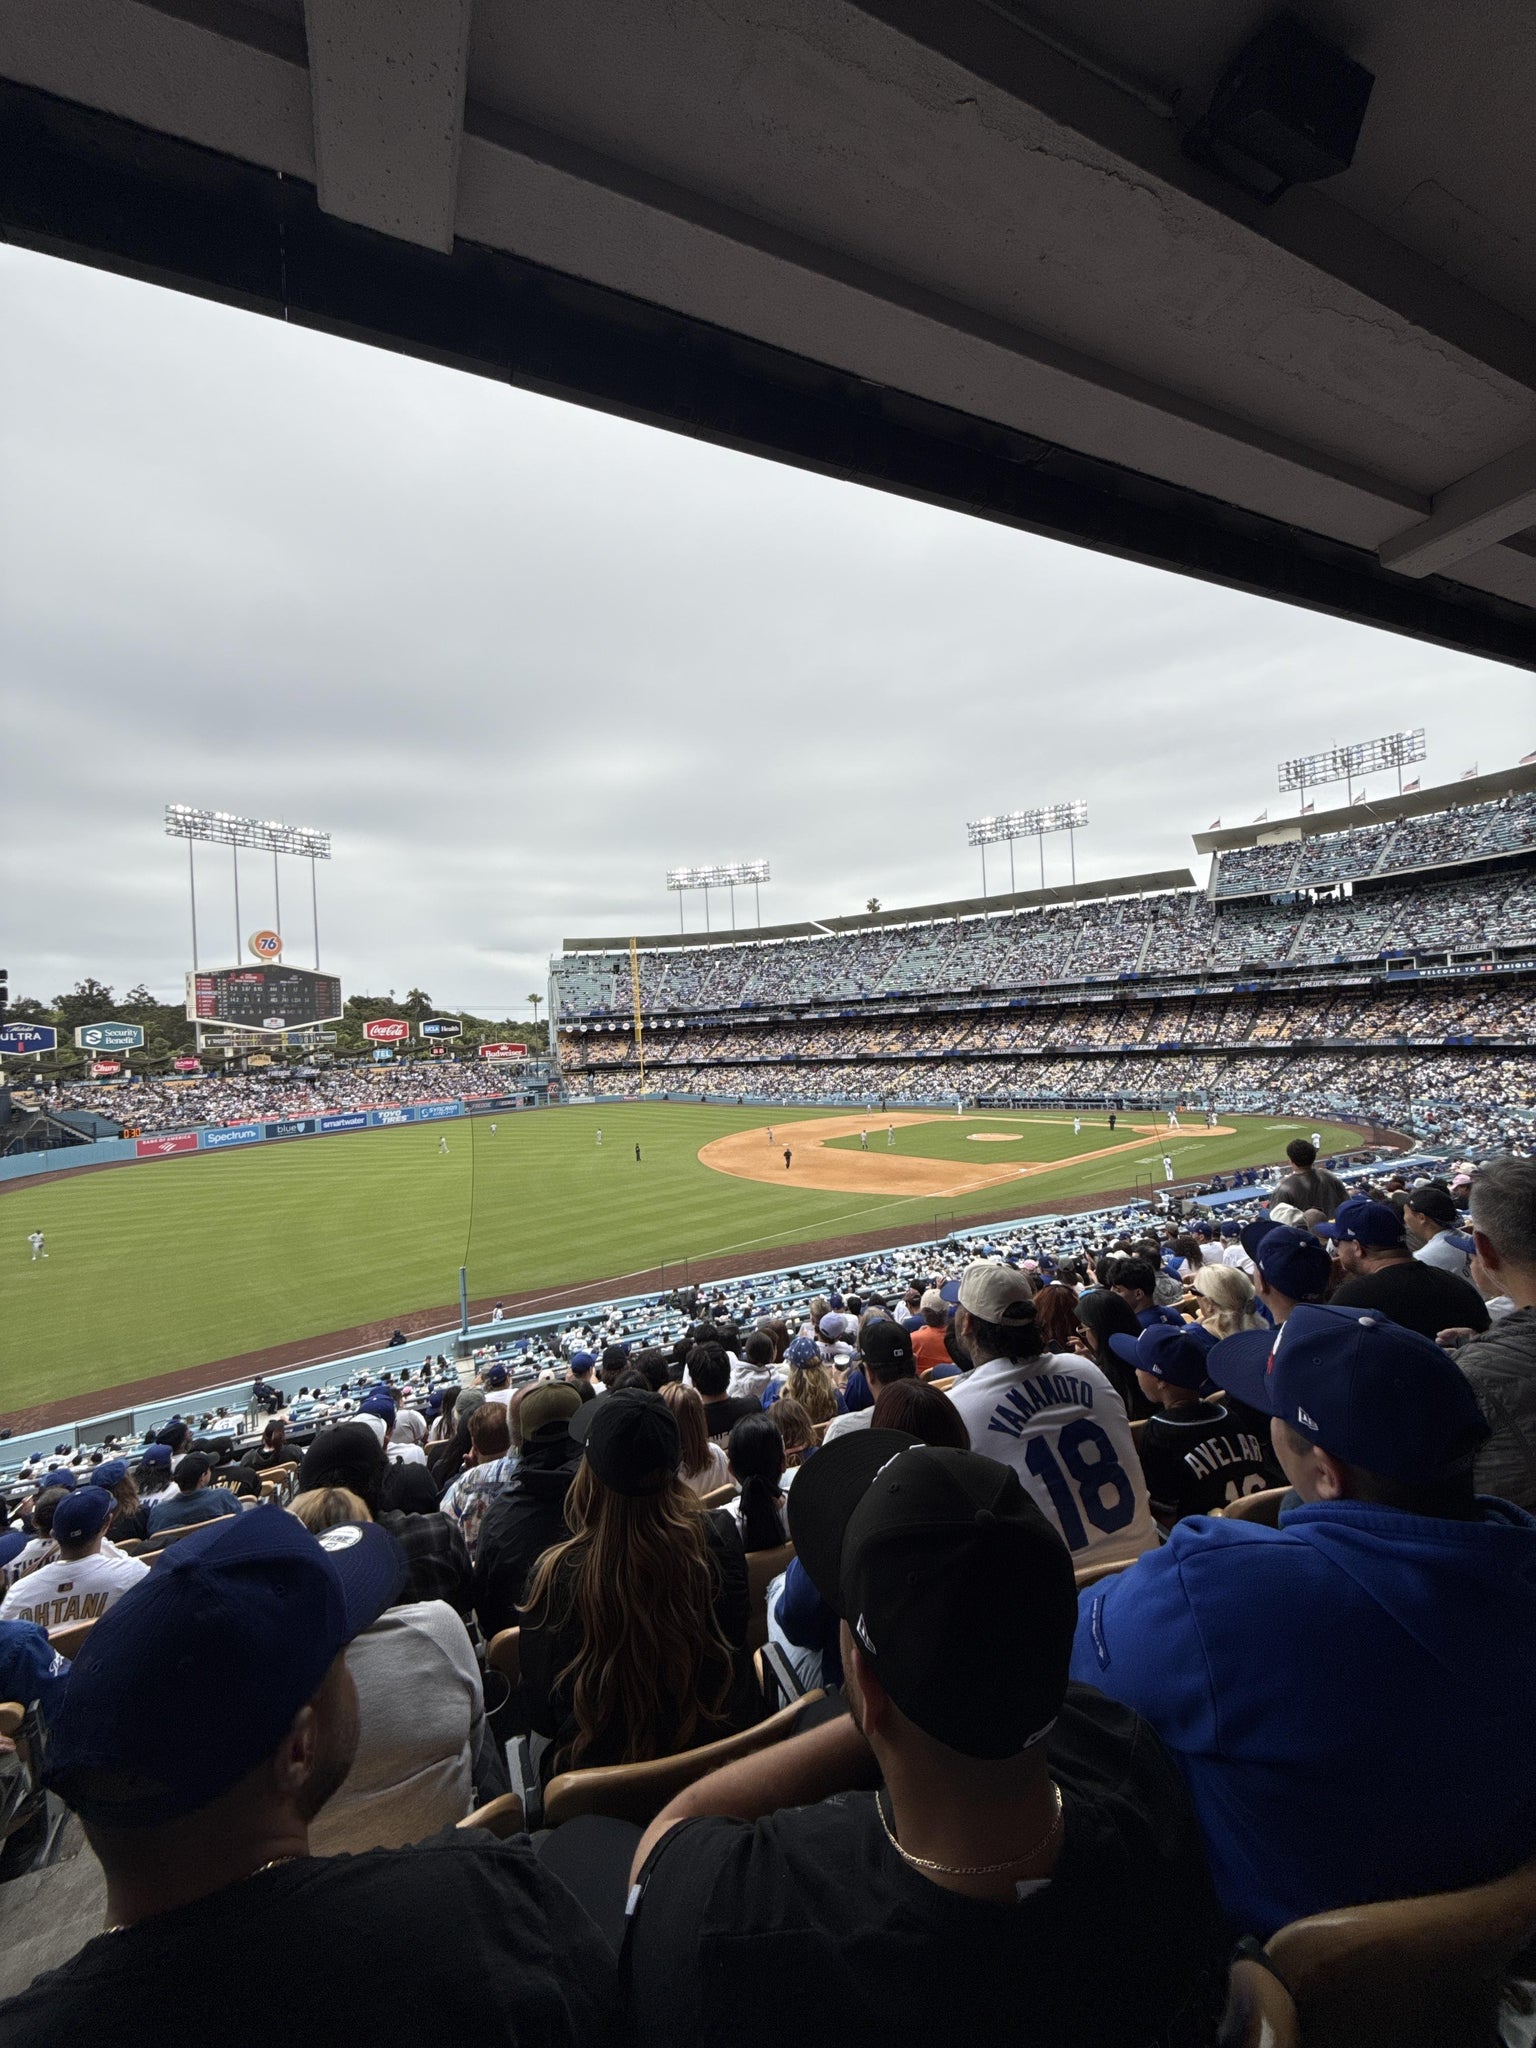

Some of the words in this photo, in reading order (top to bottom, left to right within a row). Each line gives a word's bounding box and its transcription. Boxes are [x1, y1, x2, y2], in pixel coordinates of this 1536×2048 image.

[261, 938, 277, 950] 76
[1455, 943, 1488, 951] FREDDIE
[1419, 968, 1461, 976] WELCOME
[1496, 961, 1534, 970] UNIQLO
[0, 1032, 41, 1041] ULTRA
[104, 1029, 138, 1037] Security
[105, 1036, 134, 1045] Benefit
[93, 1064, 119, 1072] Churu
[378, 1110, 402, 1119] TOYO
[322, 1117, 365, 1129] smartwater
[382, 1115, 407, 1125] TIRES
[277, 1125, 297, 1133] blue
[207, 1130, 252, 1144] Spectrum
[987, 1374, 1094, 1439] YAMAMOTO
[1183, 1433, 1263, 1480] AVELAR
[1025, 1418, 1136, 1552] 18
